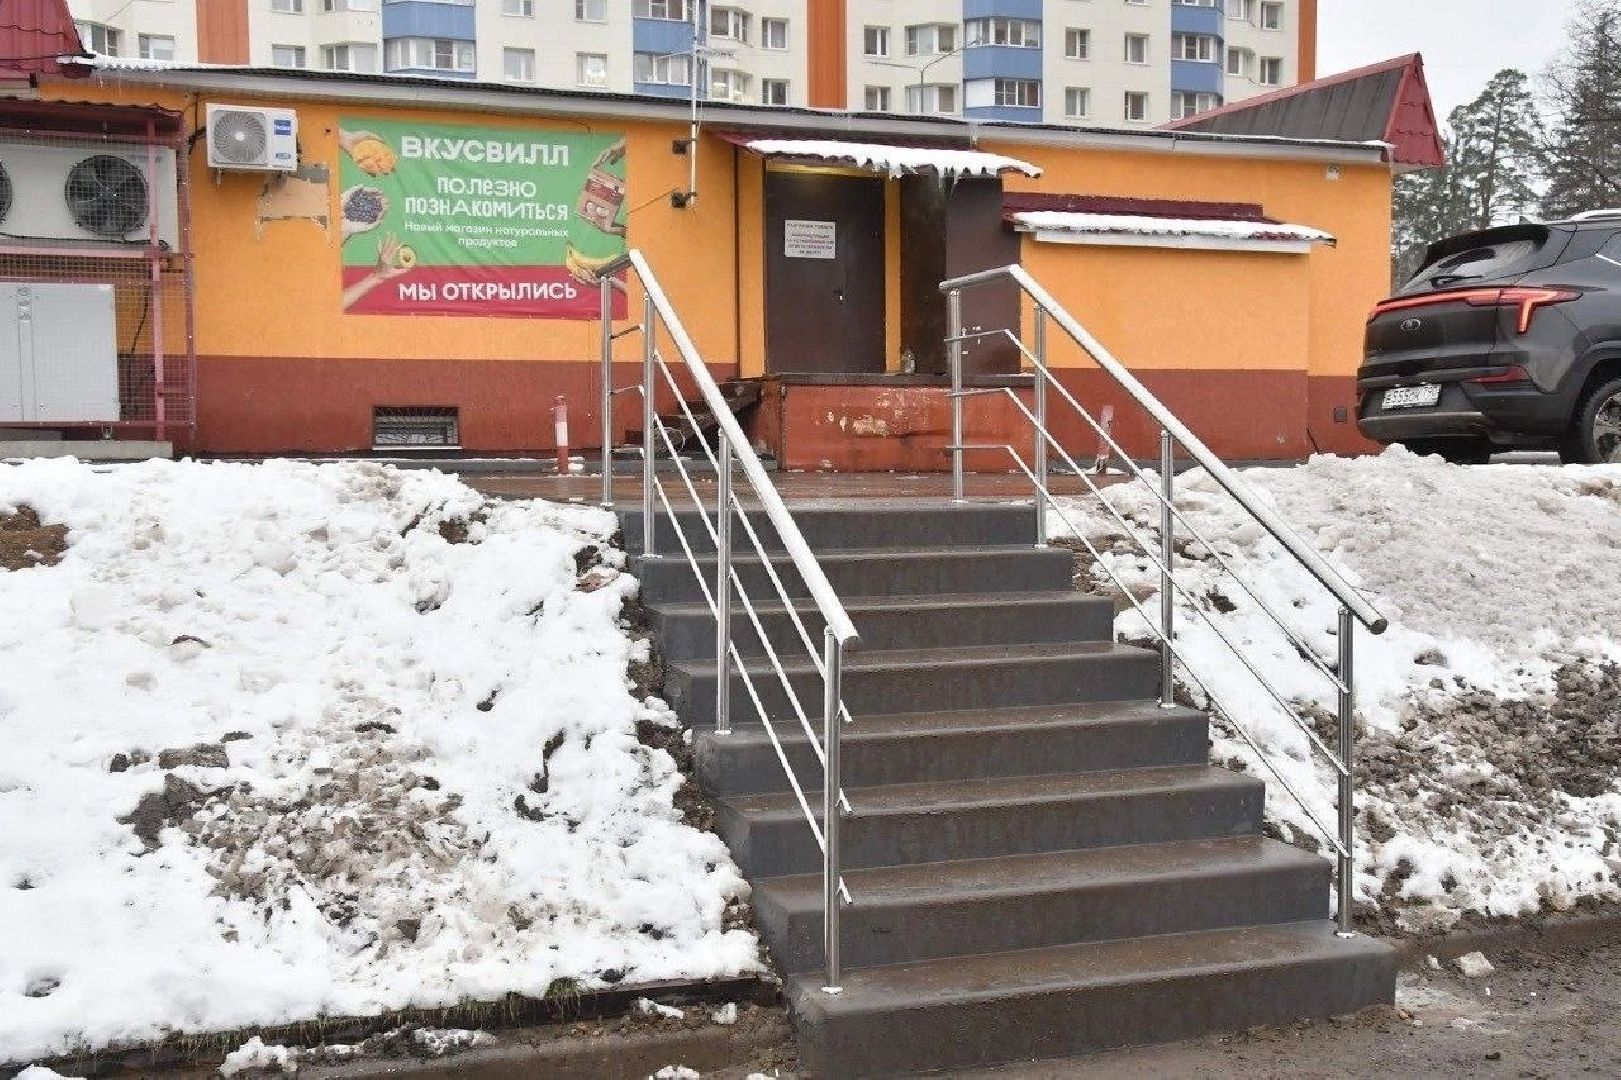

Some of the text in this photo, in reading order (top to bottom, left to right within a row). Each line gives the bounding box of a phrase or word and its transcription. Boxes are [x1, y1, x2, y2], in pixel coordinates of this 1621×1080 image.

[401, 135, 569, 166] ВКУСВИЛЛ
[405, 197, 568, 220] ПОЗНАКОМИТЬСЯ
[404, 222, 569, 237] Новый магазин натуральных
[457, 236, 517, 248] продуктов
[399, 282, 577, 301] МЫ ОТКРЫЛИСЬ
